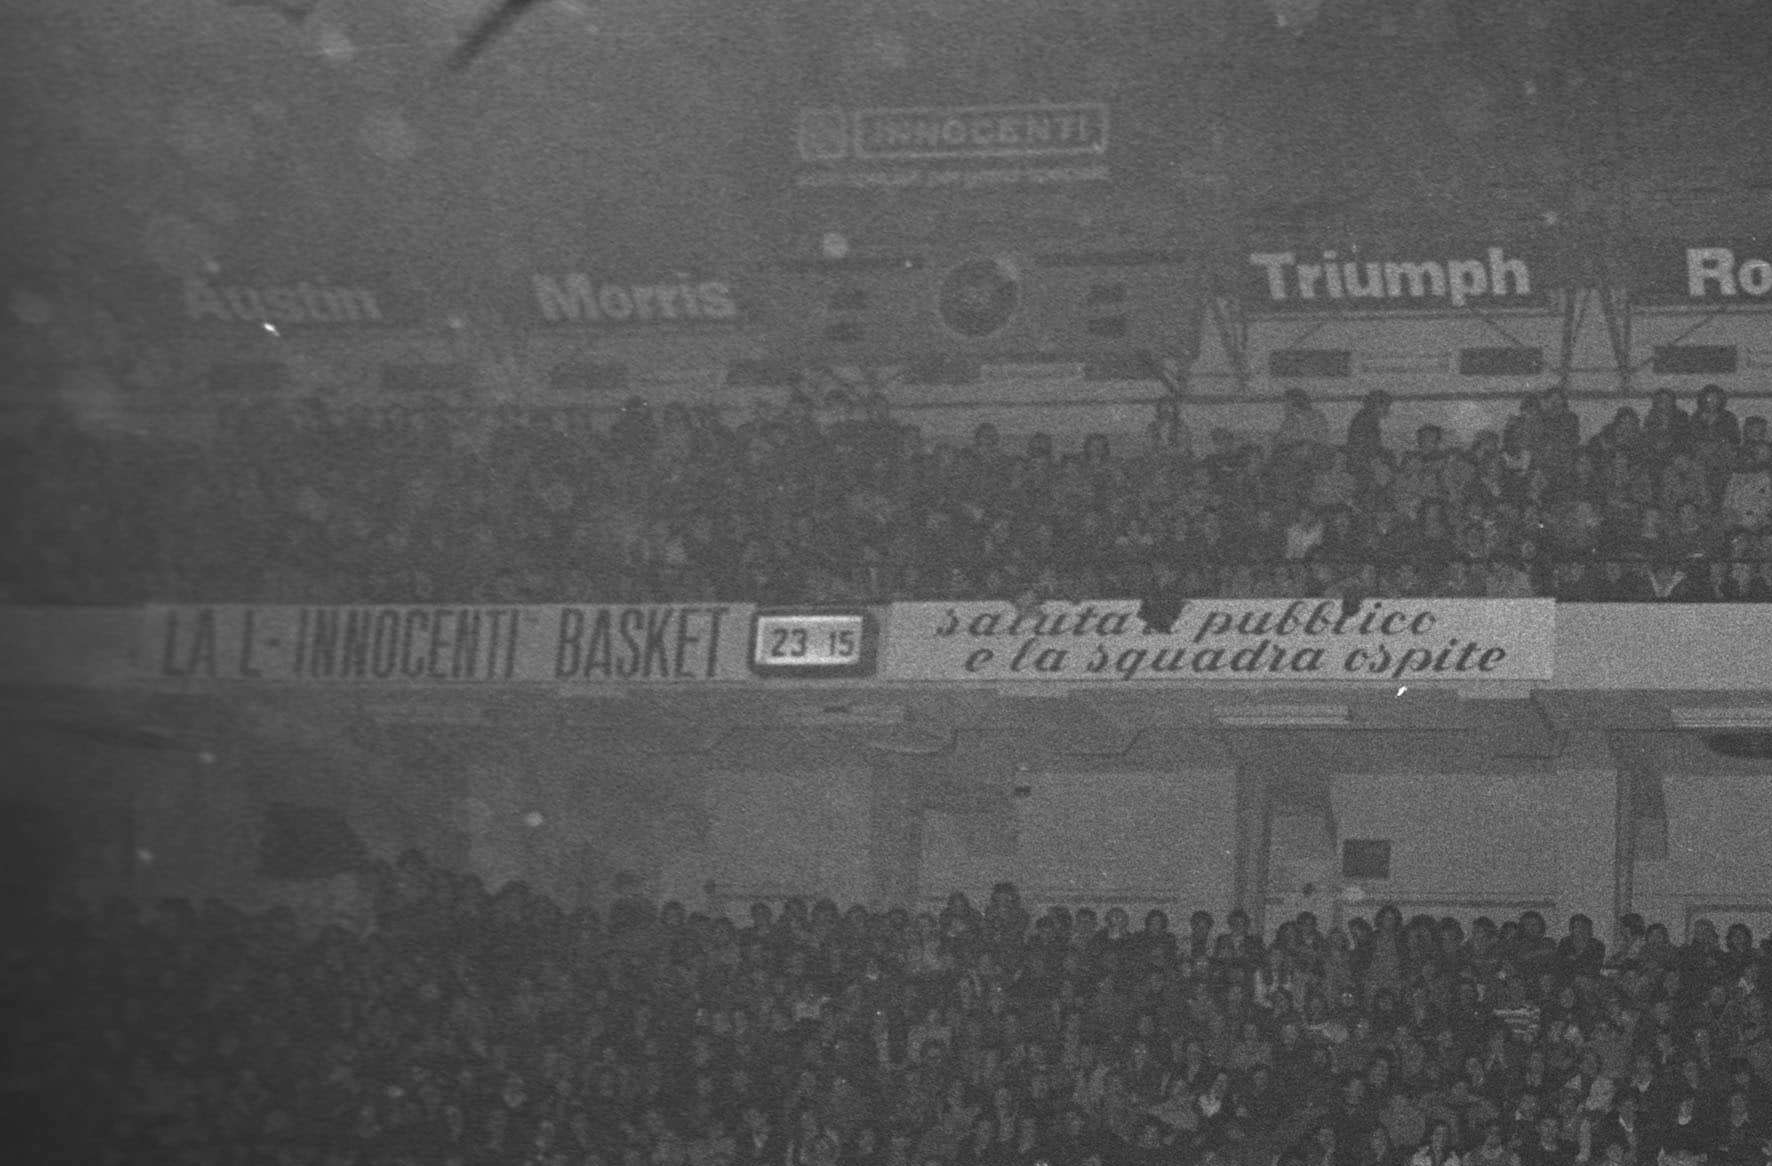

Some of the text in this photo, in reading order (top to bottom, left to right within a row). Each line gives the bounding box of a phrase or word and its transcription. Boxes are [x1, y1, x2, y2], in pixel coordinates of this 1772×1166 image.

[532, 270, 736, 320] Morris
[1250, 245, 1531, 307] Triumph
[184, 278, 382, 322] Austin
[163, 607, 215, 677] LA
[556, 606, 730, 680] BASKET
[1193, 600, 1437, 643] pubblico
[963, 636, 1507, 681] e la squadra ospite
